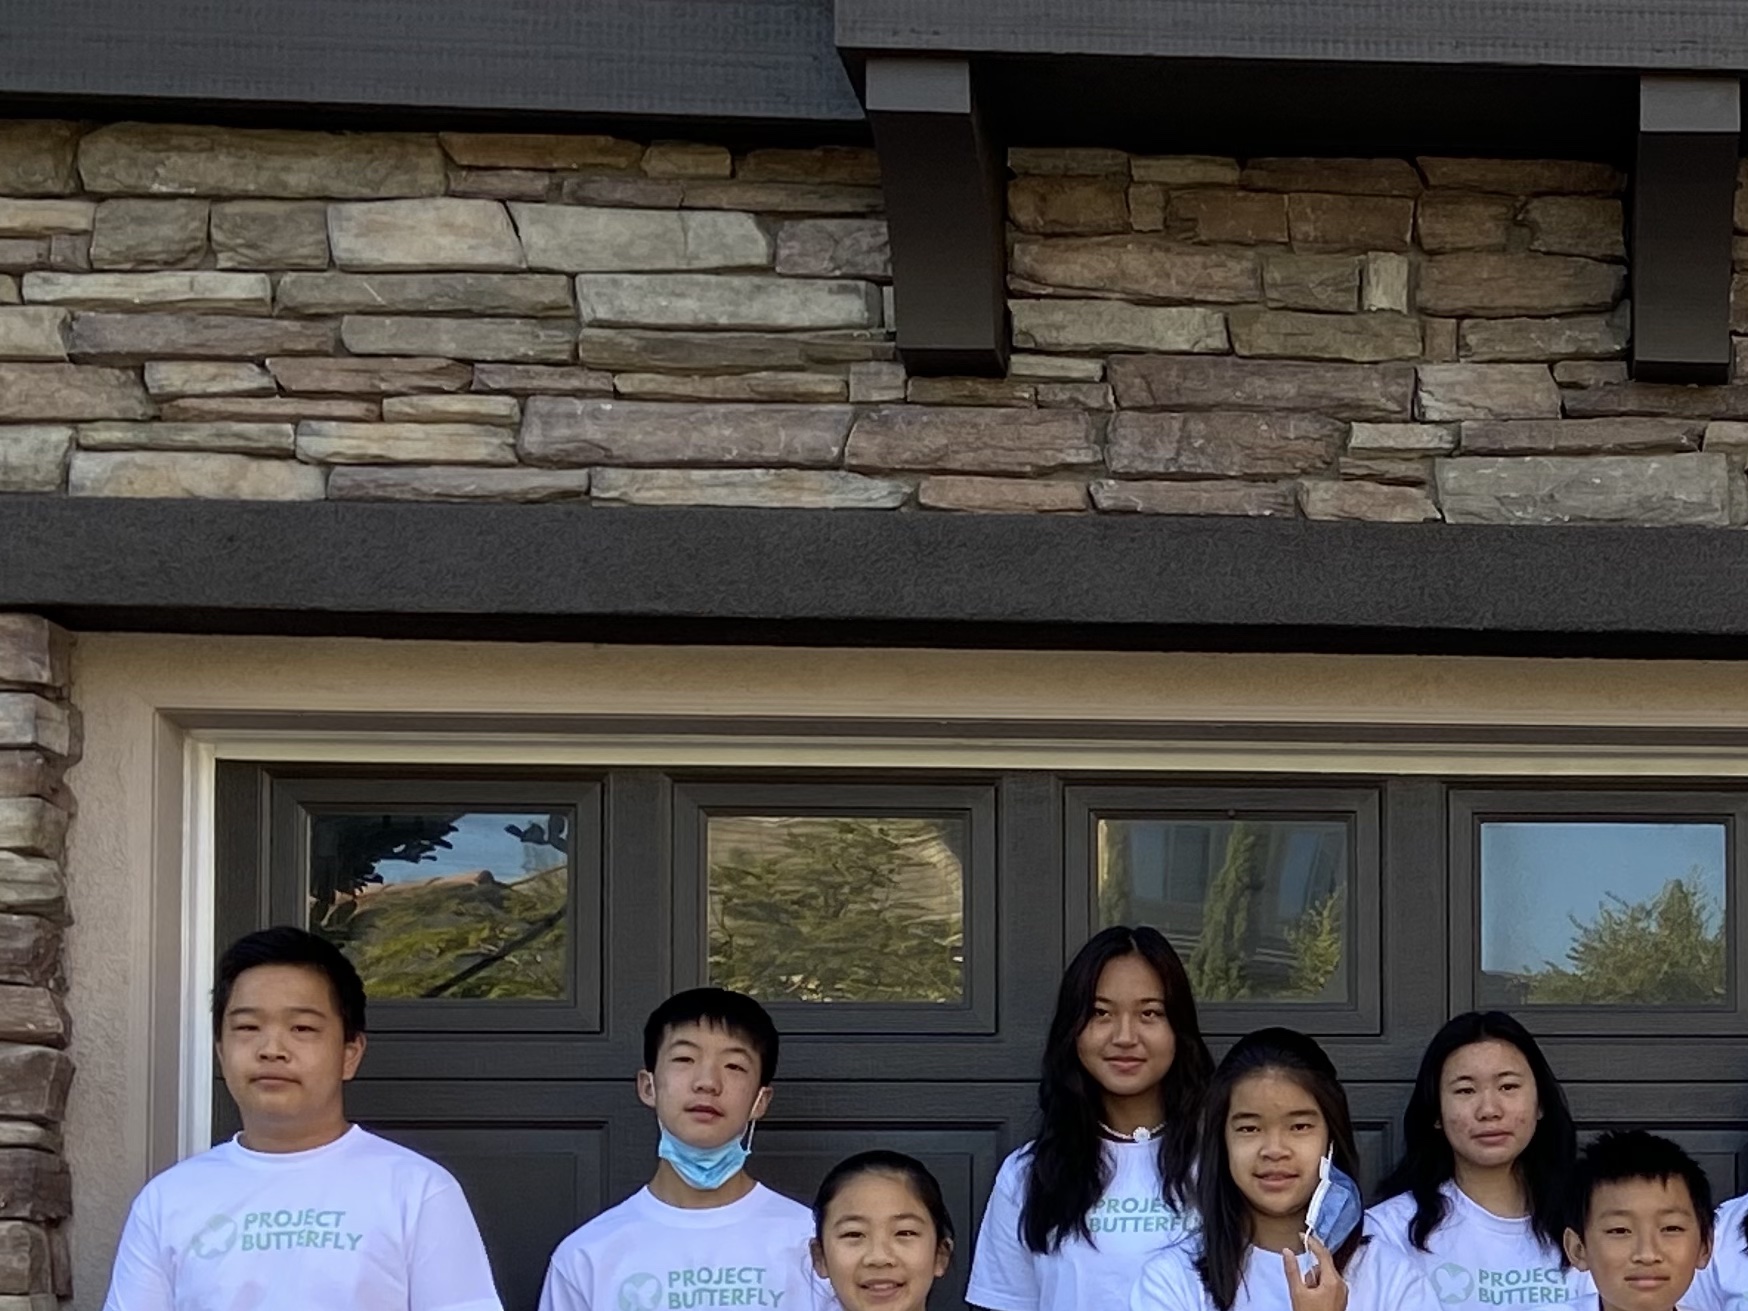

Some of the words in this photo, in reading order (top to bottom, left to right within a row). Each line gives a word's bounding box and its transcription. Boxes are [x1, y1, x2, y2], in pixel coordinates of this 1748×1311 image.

[244, 1208, 346, 1231] PROJECT
[241, 1229, 363, 1251] BUTTERFLY
[668, 1266, 766, 1288] PROJECT
[668, 1288, 785, 1310] BUTTERFLY
